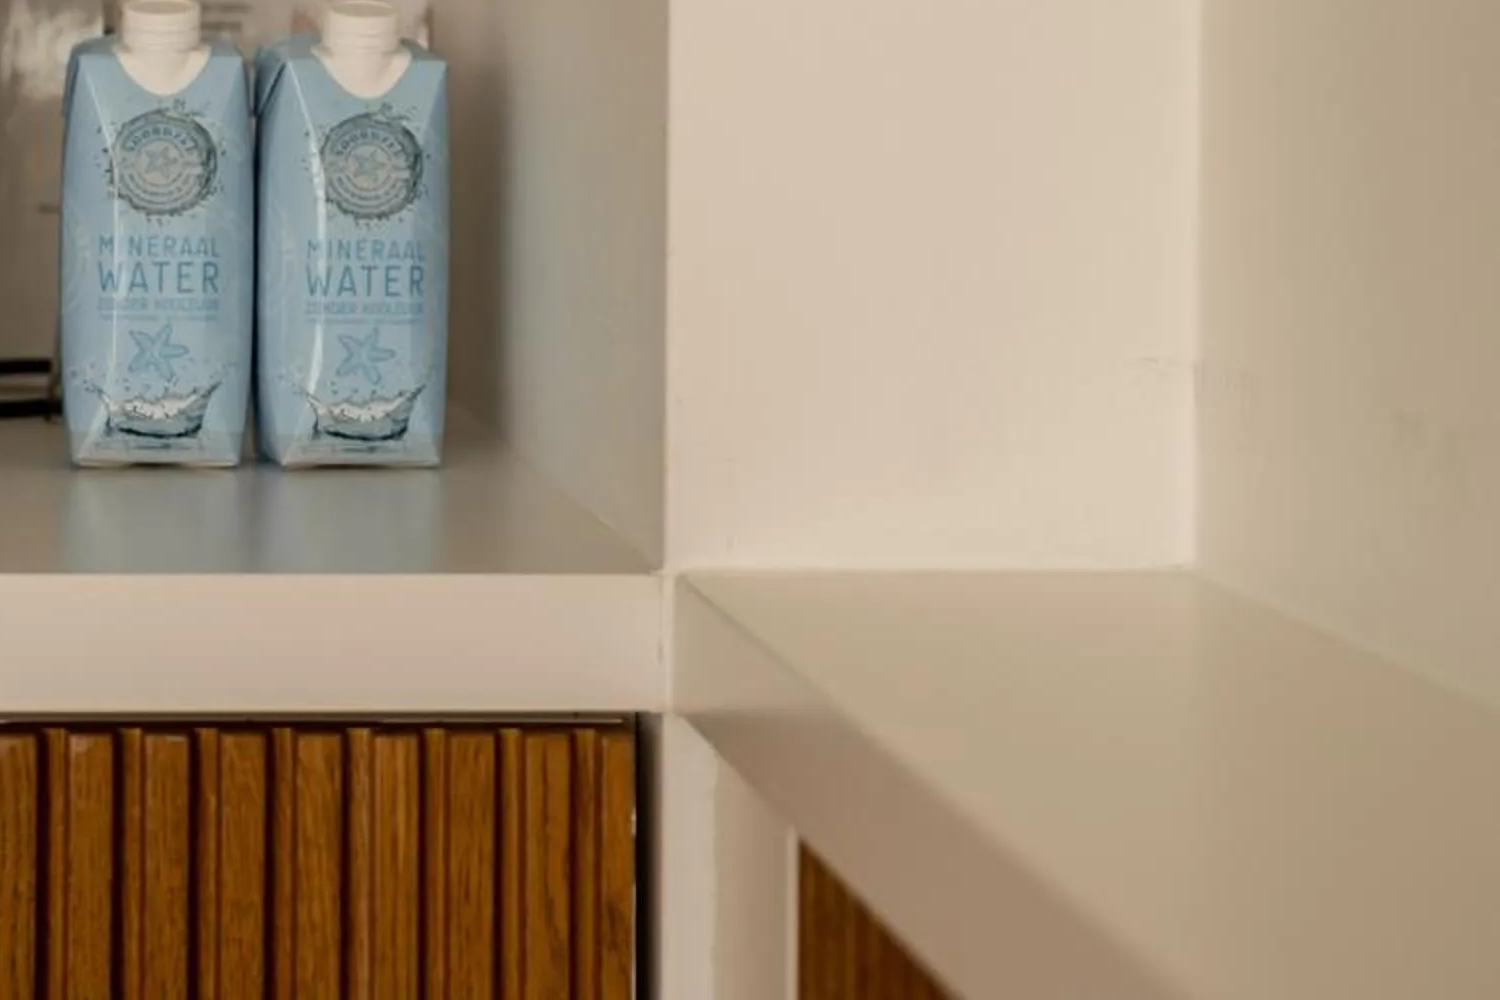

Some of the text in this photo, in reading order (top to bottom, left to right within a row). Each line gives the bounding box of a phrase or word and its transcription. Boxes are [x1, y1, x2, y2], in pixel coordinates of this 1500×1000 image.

[98, 235, 220, 258] MNERAAL
[97, 260, 219, 295] WATER
[305, 263, 424, 297] WATER
